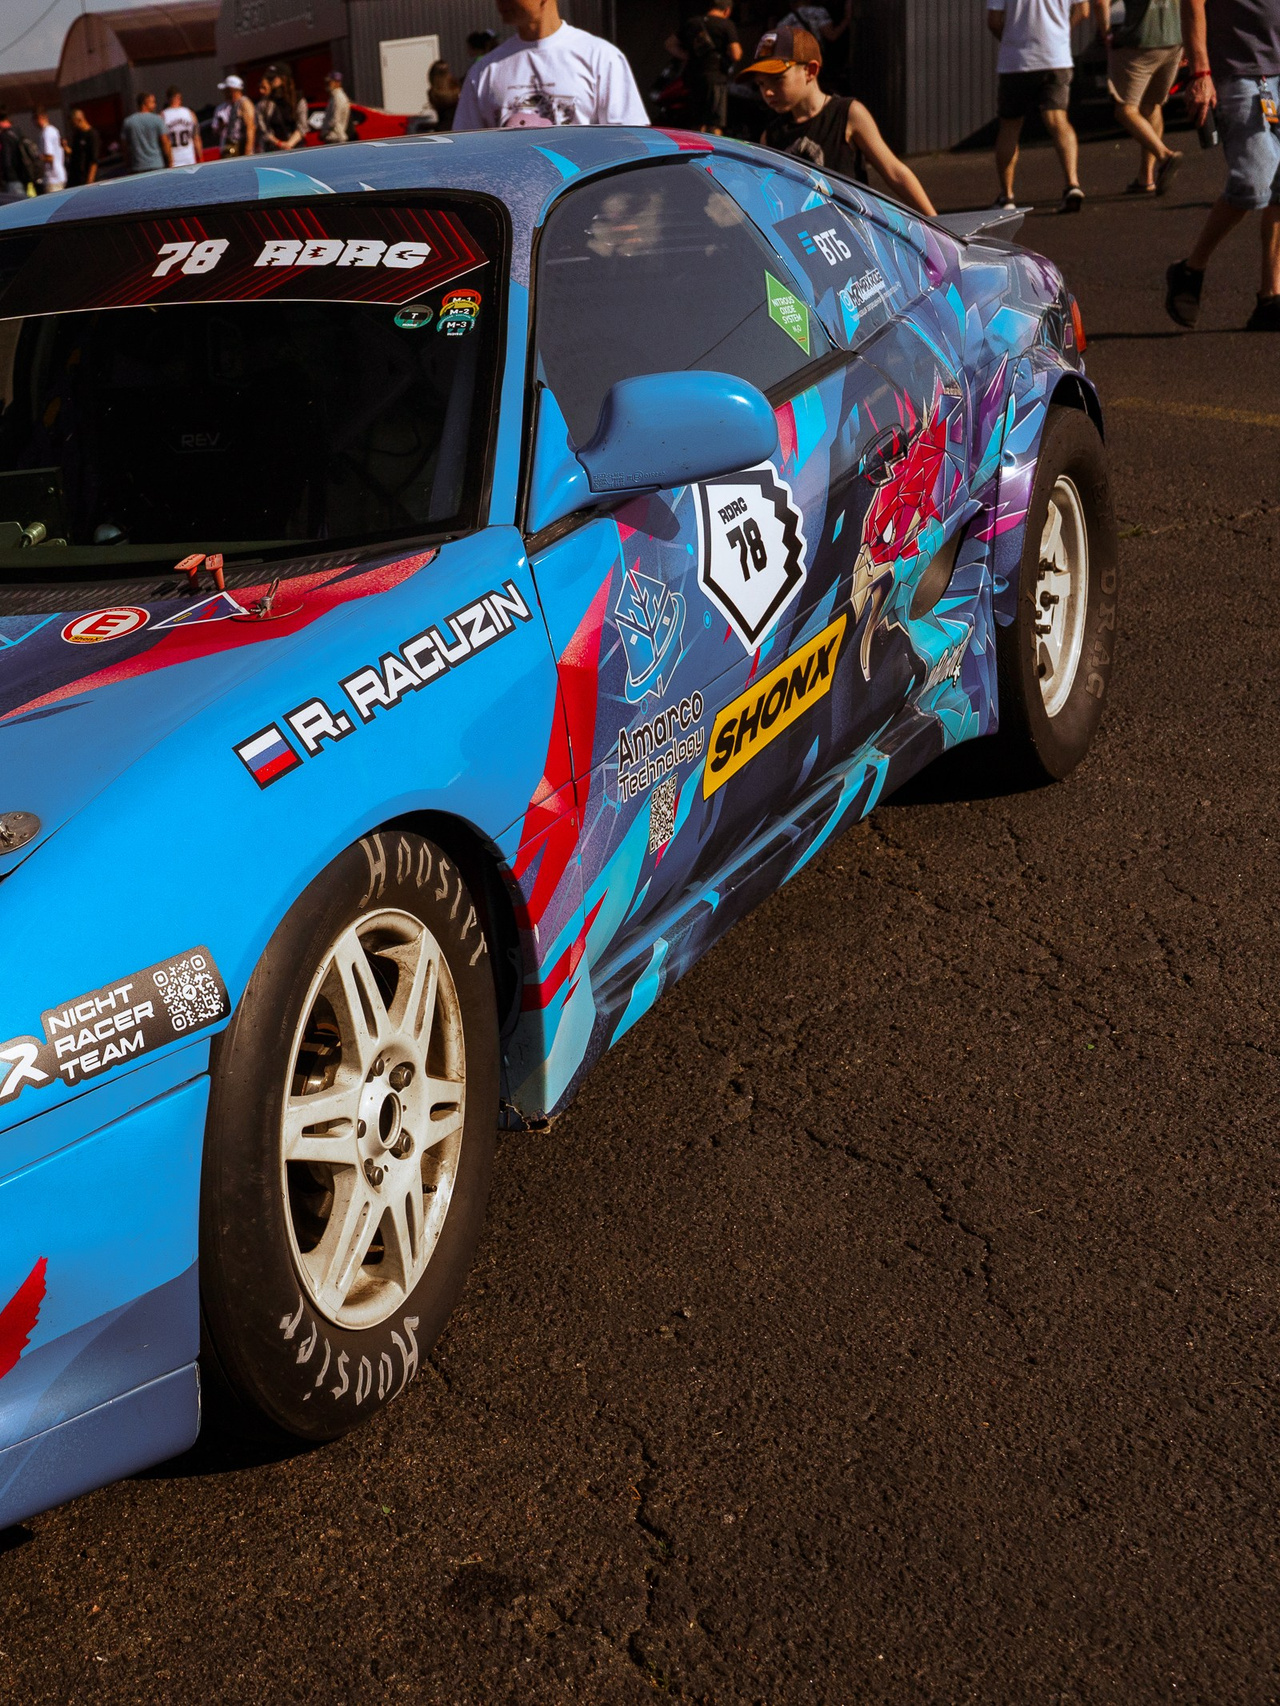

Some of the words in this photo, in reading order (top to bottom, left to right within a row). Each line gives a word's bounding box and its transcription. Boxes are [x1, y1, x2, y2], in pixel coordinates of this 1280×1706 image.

[152, 238, 230, 277] 78
[812, 228, 852, 266] ВТБ
[771, 296, 795, 307] NITROUS
[782, 313, 802, 325] SYSTEM
[726, 517, 768, 582] 78
[80, 614, 131, 635] E
[288, 701, 352, 751] R.
[343, 583, 530, 718] RAGUZIN
[710, 635, 838, 773] SHONX
[618, 690, 703, 773] Amarco
[619, 726, 705, 803] Technology
[48, 983, 133, 1035] NIGHT
[54, 1000, 155, 1058] RACER
[60, 1030, 145, 1079] TEAM
